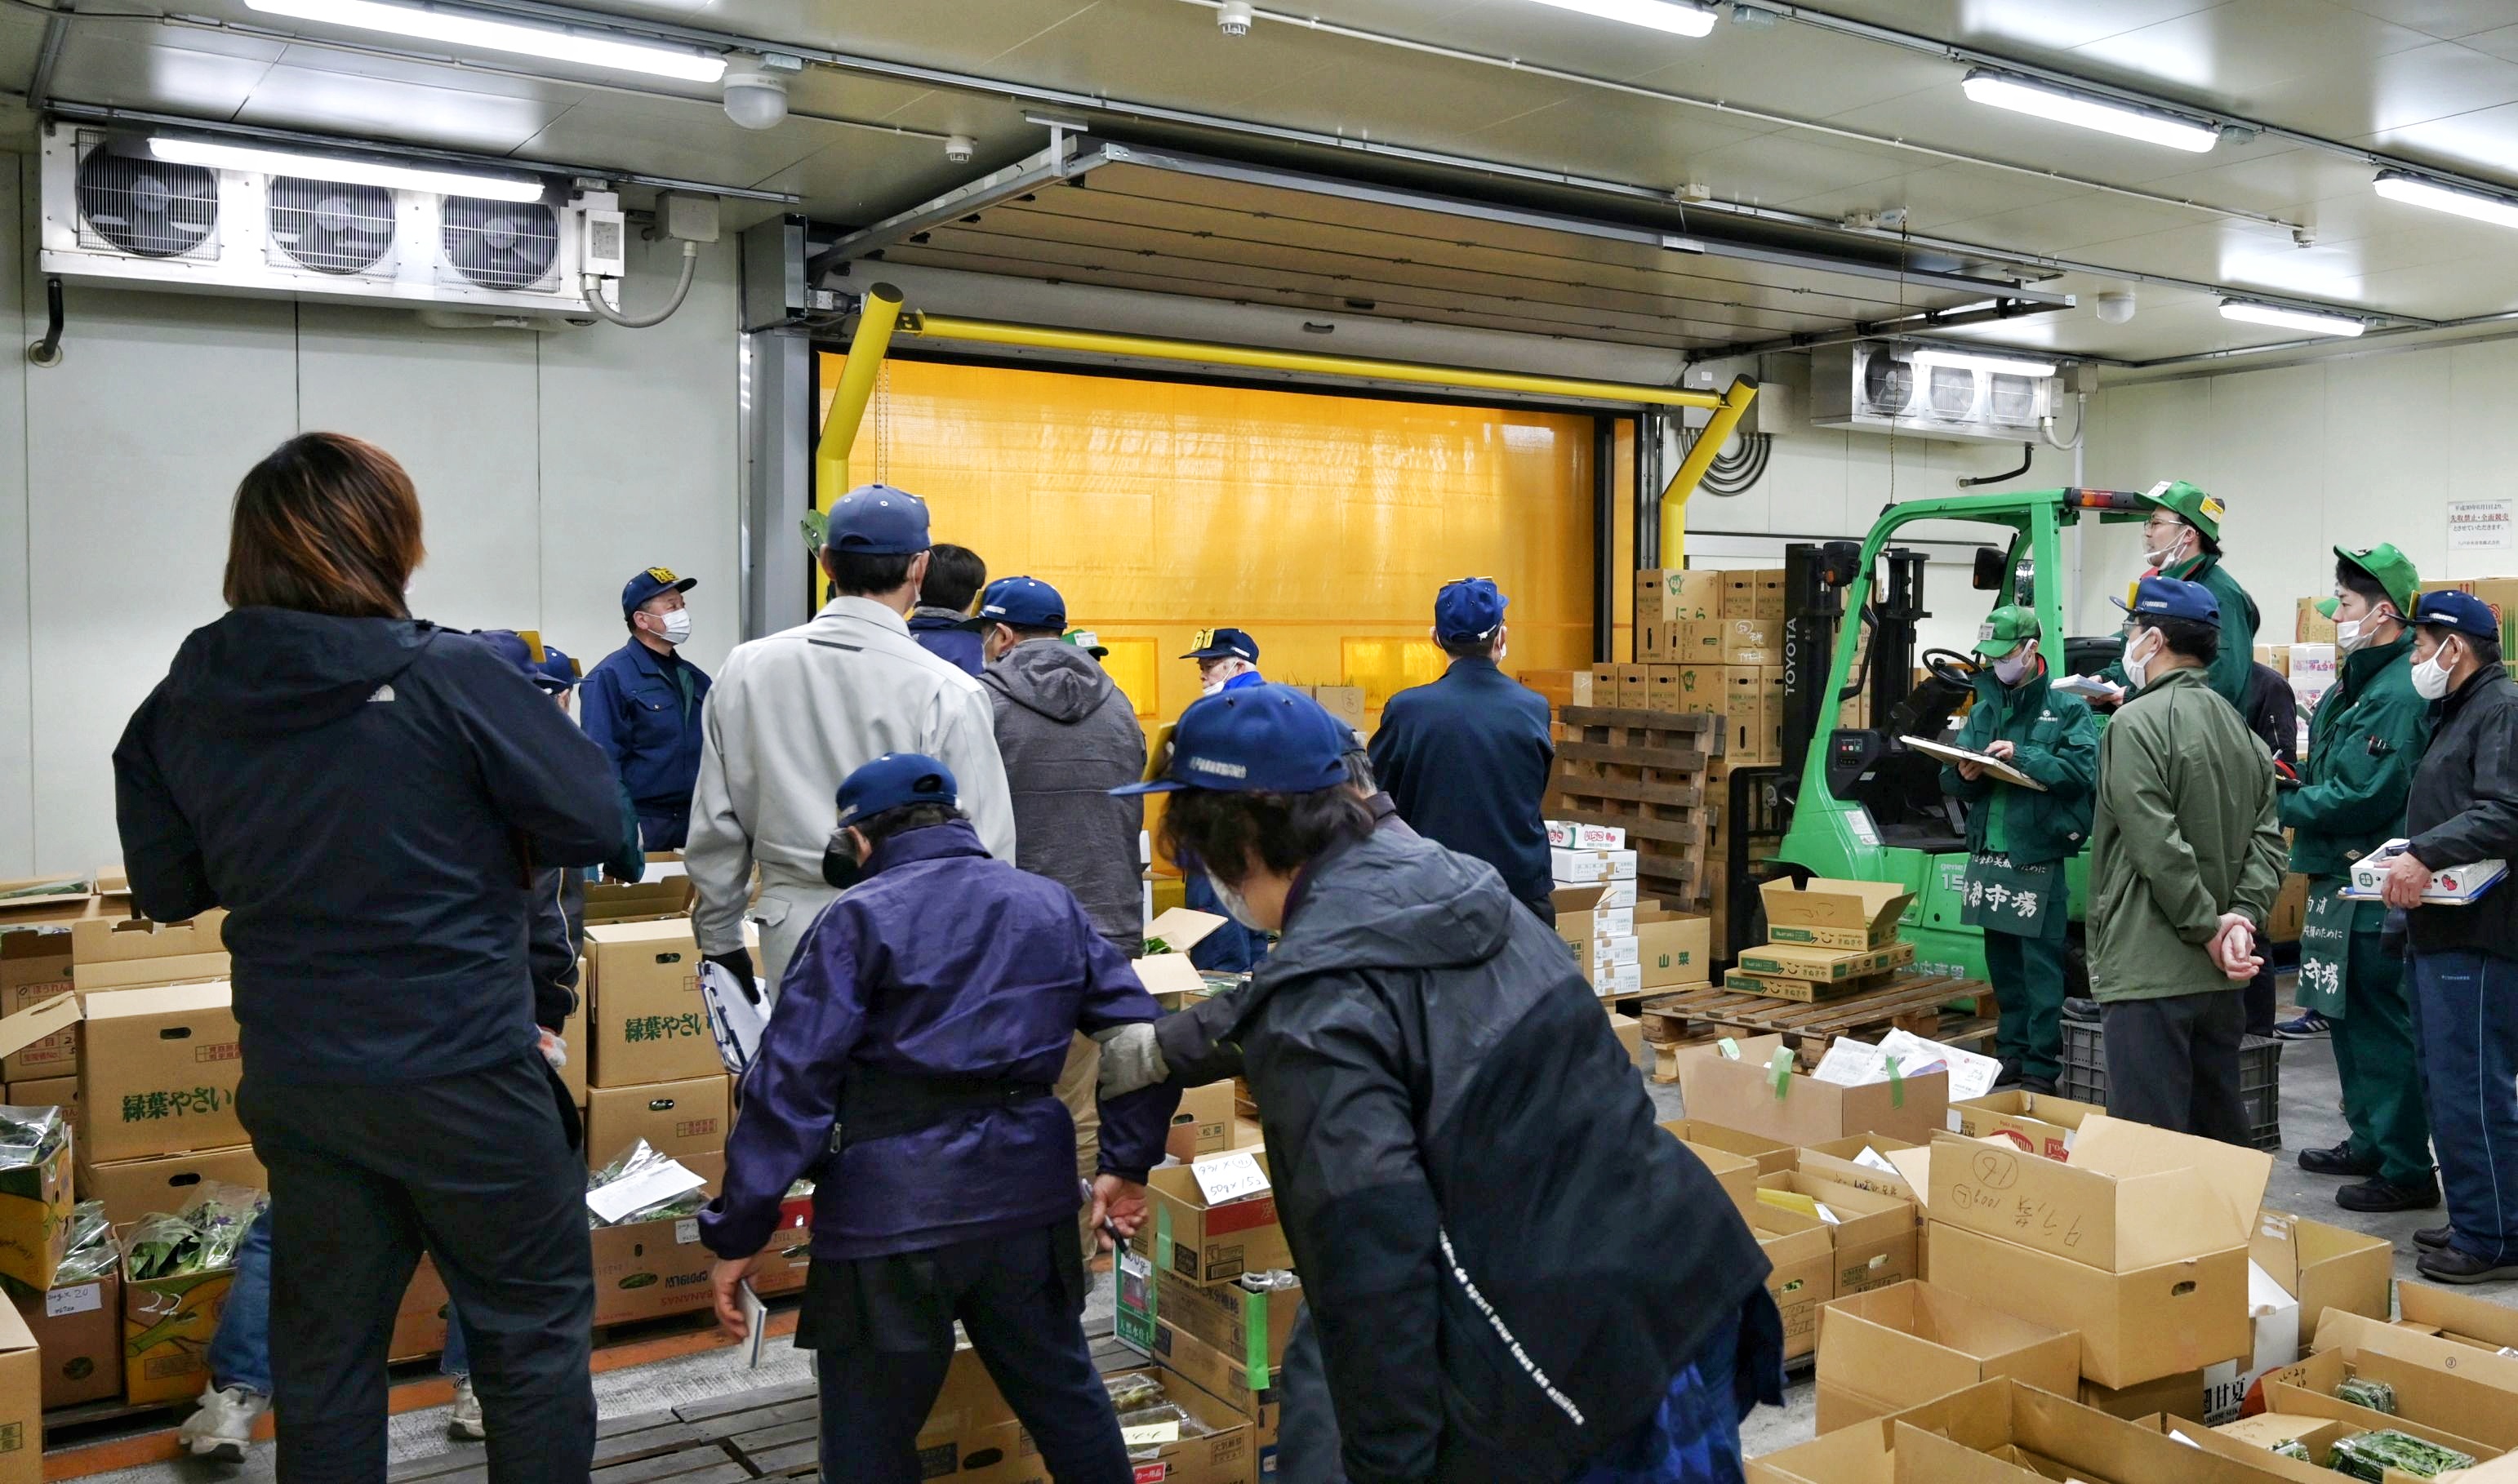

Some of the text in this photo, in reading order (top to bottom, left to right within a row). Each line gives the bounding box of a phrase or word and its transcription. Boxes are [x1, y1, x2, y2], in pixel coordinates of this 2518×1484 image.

[1786, 617, 1797, 696] TOYOTA
[1584, 830, 1604, 842] いちご
[1659, 950, 1690, 968] 山菜
[625, 1012, 715, 1043] 緑葉やさい
[122, 1086, 234, 1123] 緑葉やさい
[661, 1290, 714, 1307] BANANAS
